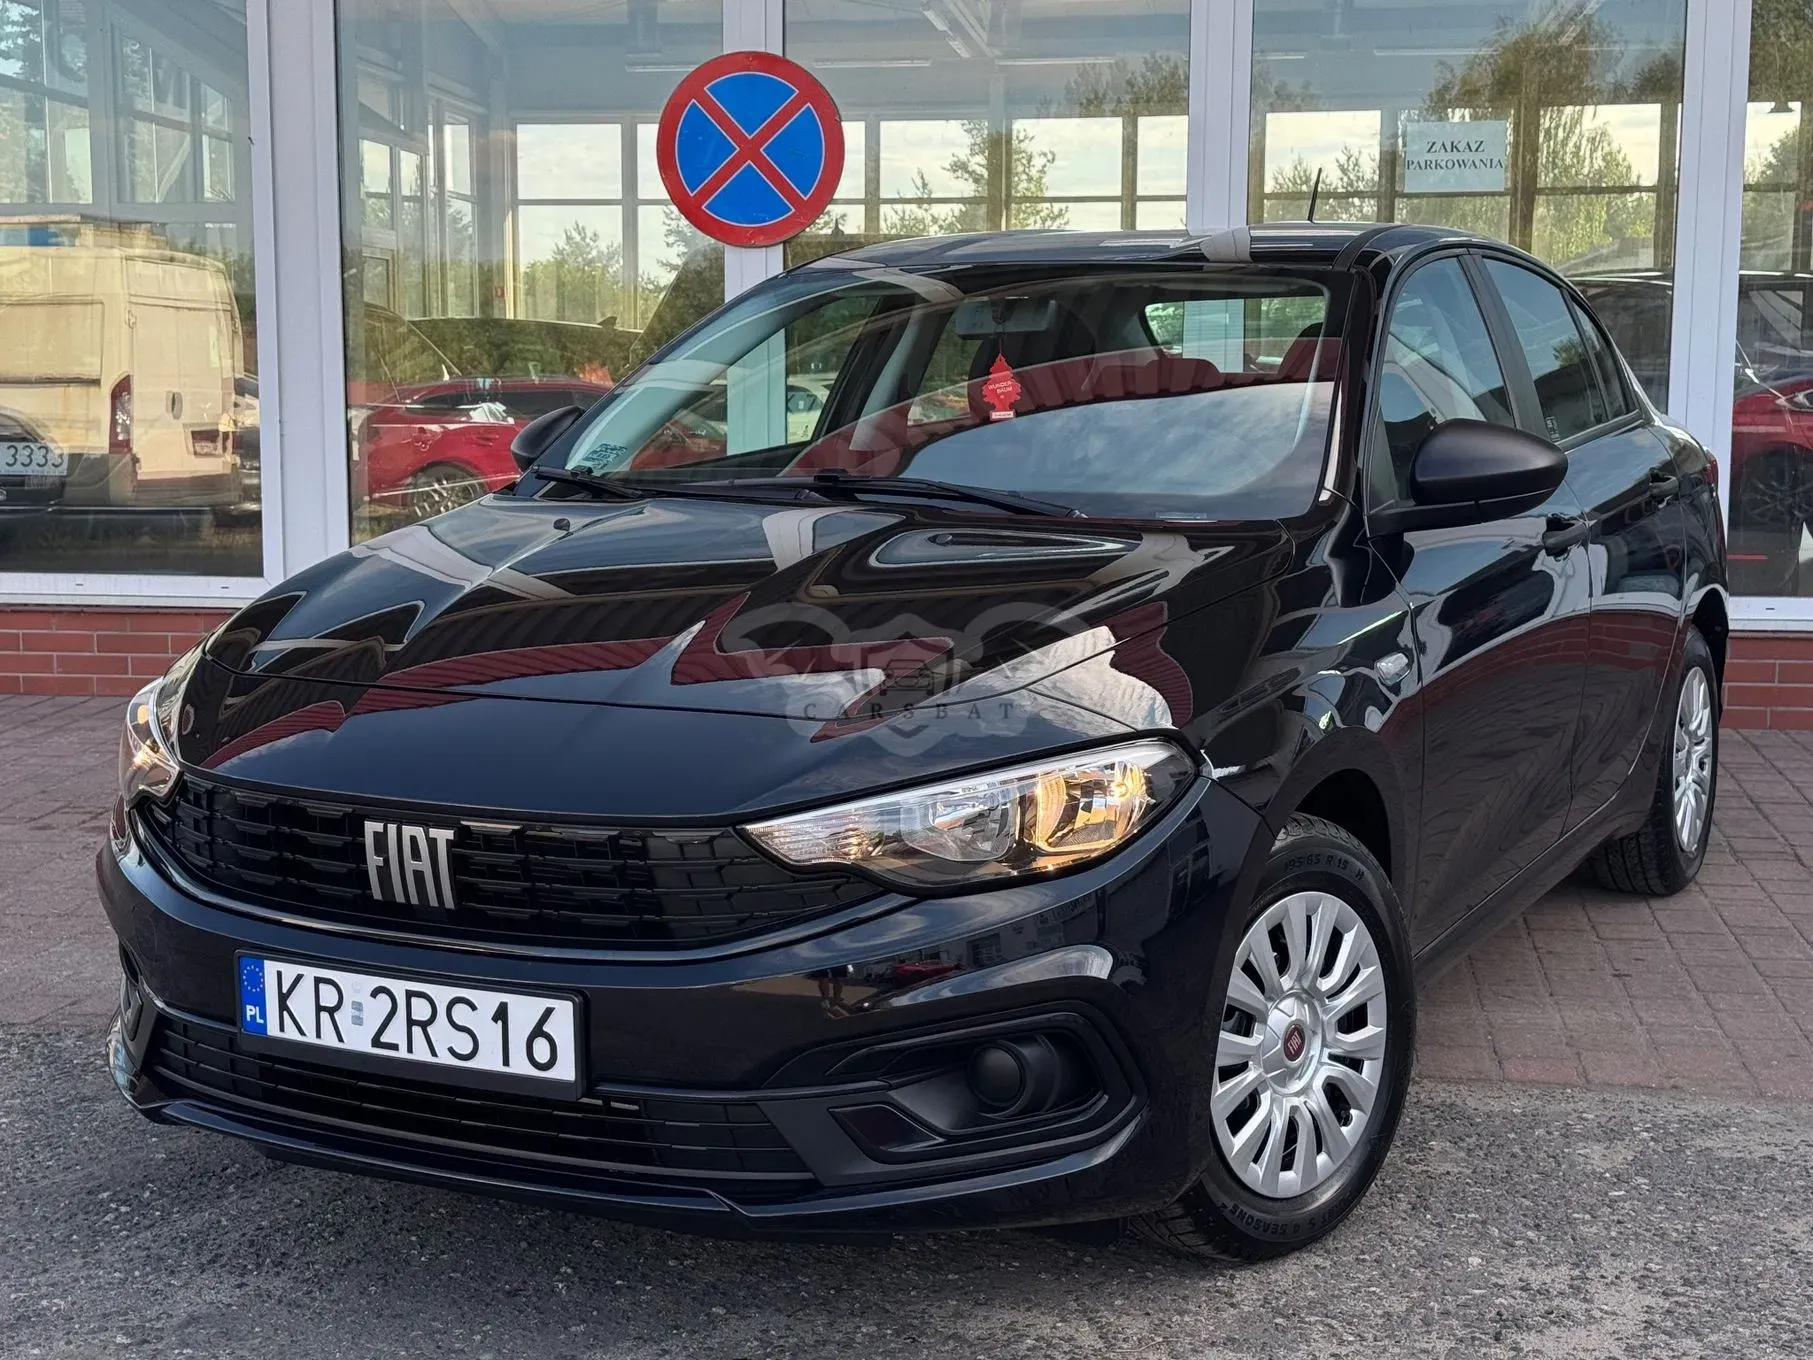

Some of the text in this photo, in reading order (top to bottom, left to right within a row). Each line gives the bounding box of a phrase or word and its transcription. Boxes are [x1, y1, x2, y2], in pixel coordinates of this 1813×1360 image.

[1426, 140, 1485, 153] ZAKAZ
[1406, 158, 1504, 170] PARKOWANIA
[364, 820, 455, 910] FIAT
[246, 1004, 264, 1024] PL
[276, 969, 345, 1043] KR
[369, 985, 559, 1072] 2RS16
[1287, 1030, 1302, 1055] FIAT
